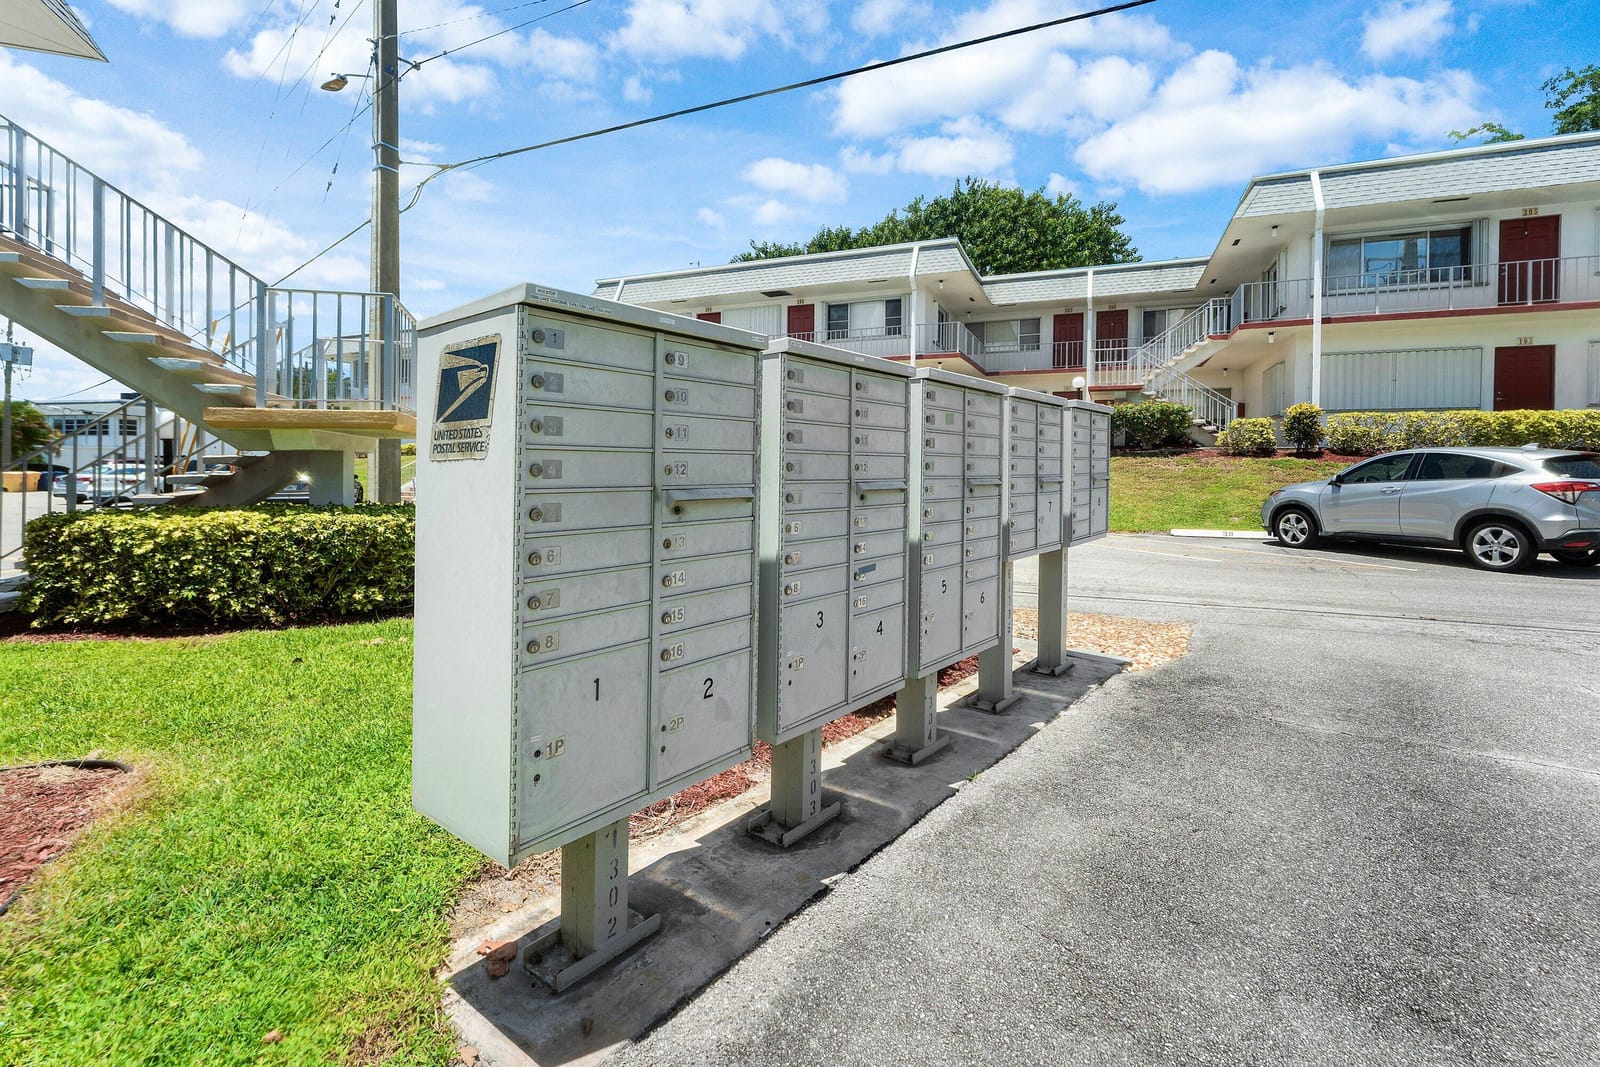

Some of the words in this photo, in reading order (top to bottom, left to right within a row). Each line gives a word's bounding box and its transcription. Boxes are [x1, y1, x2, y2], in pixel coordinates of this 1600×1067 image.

[677, 354, 685, 366] 9
[675, 390, 687, 403] 10
[434, 429, 459, 441] UNITED
[459, 427, 483, 439] STATES
[675, 427, 688, 439] 11
[432, 442, 457, 454] POSTAL
[457, 441, 486, 453] SERVICE
[675, 464, 687, 476] 12
[546, 549, 555, 563] 6
[672, 571, 684, 585] 14
[793, 583, 799, 593] 8
[941, 579, 947, 594] 5
[546, 591, 555, 606] 7
[980, 591, 985, 604] 6
[671, 608, 684, 622] 15
[816, 610, 824, 628] 3
[876, 620, 883, 636] 4
[545, 635, 554, 649] 8
[671, 644, 683, 658] 16
[794, 656, 804, 668] 1P
[593, 677, 600, 702] 1
[703, 677, 714, 700] 2
[669, 716, 685, 732] 2P
[546, 739, 564, 755] 1P
[607, 828, 619, 940] 1302
